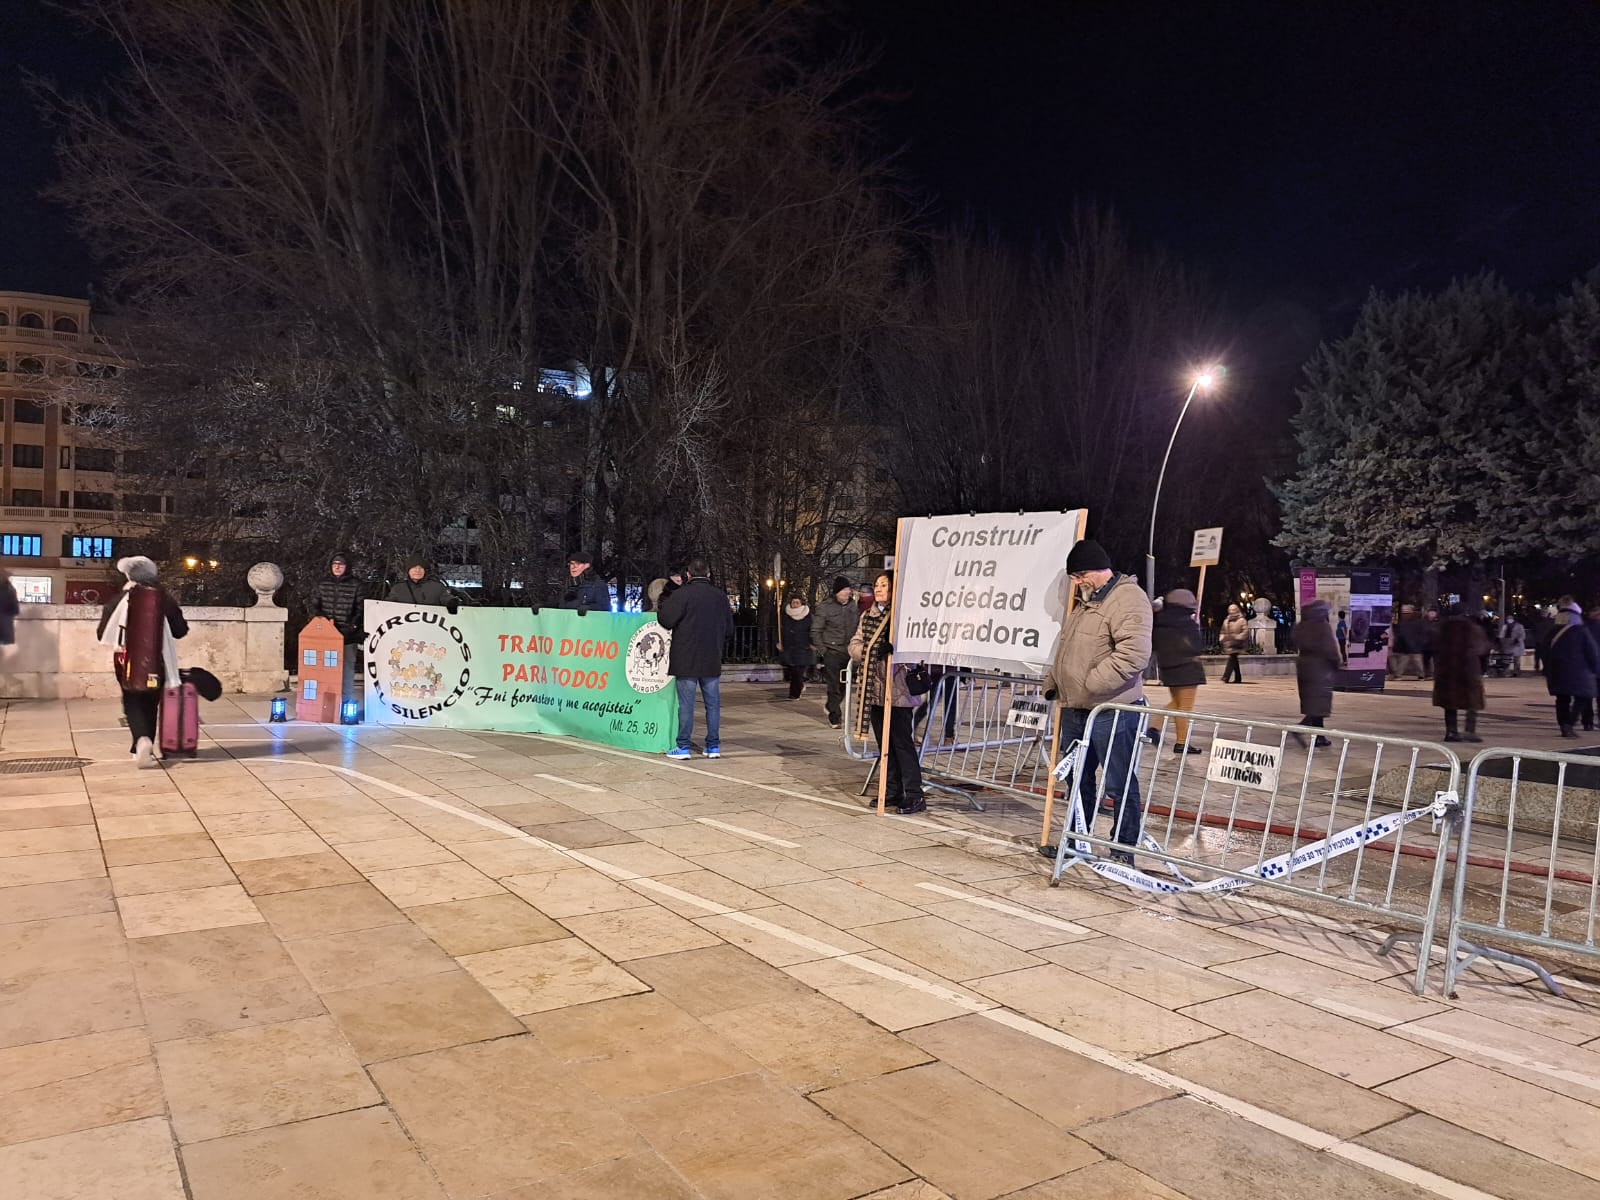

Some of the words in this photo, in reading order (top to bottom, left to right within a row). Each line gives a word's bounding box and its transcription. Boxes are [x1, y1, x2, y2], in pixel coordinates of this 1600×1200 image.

[932, 523, 1043, 548] Construir
[954, 559, 998, 577] una
[920, 585, 1027, 611] sociedad
[369, 612, 472, 662] CIRCULOS
[905, 616, 1040, 648] integradora
[498, 634, 554, 655] TRATO
[558, 638, 619, 660] DIGNO
[502, 663, 548, 685] PARA
[551, 666, 609, 690] TODOS
[632, 682, 660, 693] BURGOS
[391, 668, 470, 719] SILENCIO
[557, 698, 563, 713] y
[566, 699, 579, 710] me
[610, 719, 625, 734] (Mt.
[627, 720, 640, 735] 25,
[643, 722, 658, 738] 38)
[1220, 765, 1262, 785] BURGOS
